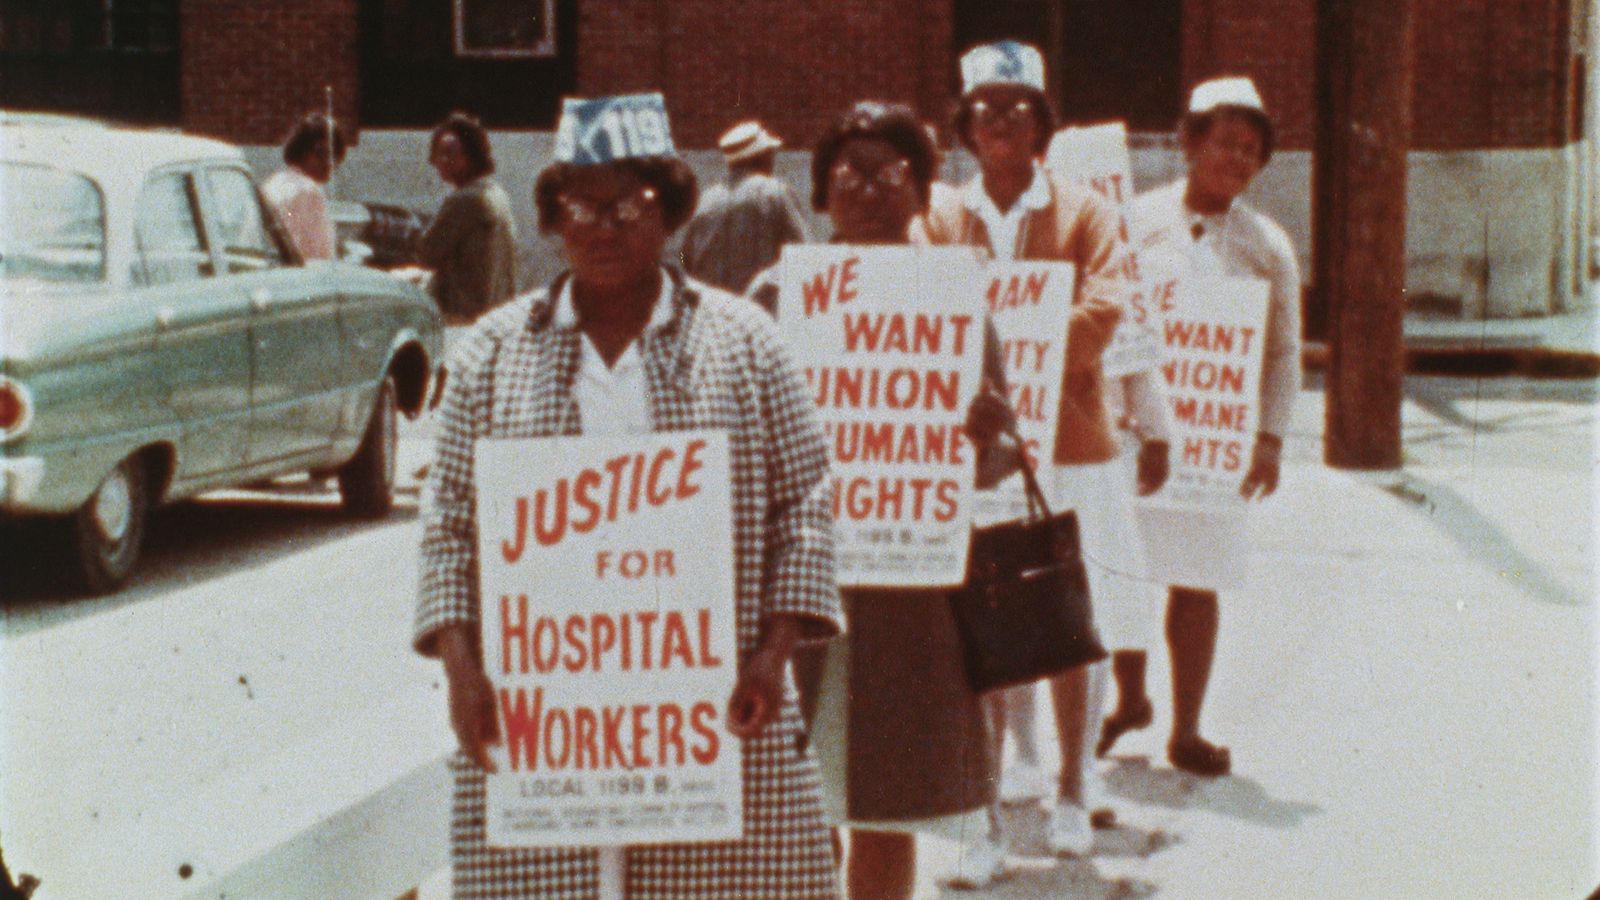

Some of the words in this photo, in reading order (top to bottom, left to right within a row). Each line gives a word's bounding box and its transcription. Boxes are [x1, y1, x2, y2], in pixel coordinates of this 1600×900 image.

[802, 256, 861, 319] WE
[843, 312, 972, 356] WANT
[1164, 320, 1256, 356] WANT
[1160, 359, 1245, 396] NION
[1170, 398, 1247, 433] MANE
[826, 421, 966, 465] UMANE
[1184, 437, 1242, 472] HTS
[501, 439, 706, 563] JUSTICE
[832, 476, 960, 522] IGHTS
[596, 549, 676, 579] FOR
[499, 593, 722, 674] HOSPITAL
[499, 686, 721, 772] WORKERS
[518, 778, 584, 798] LOCAL
